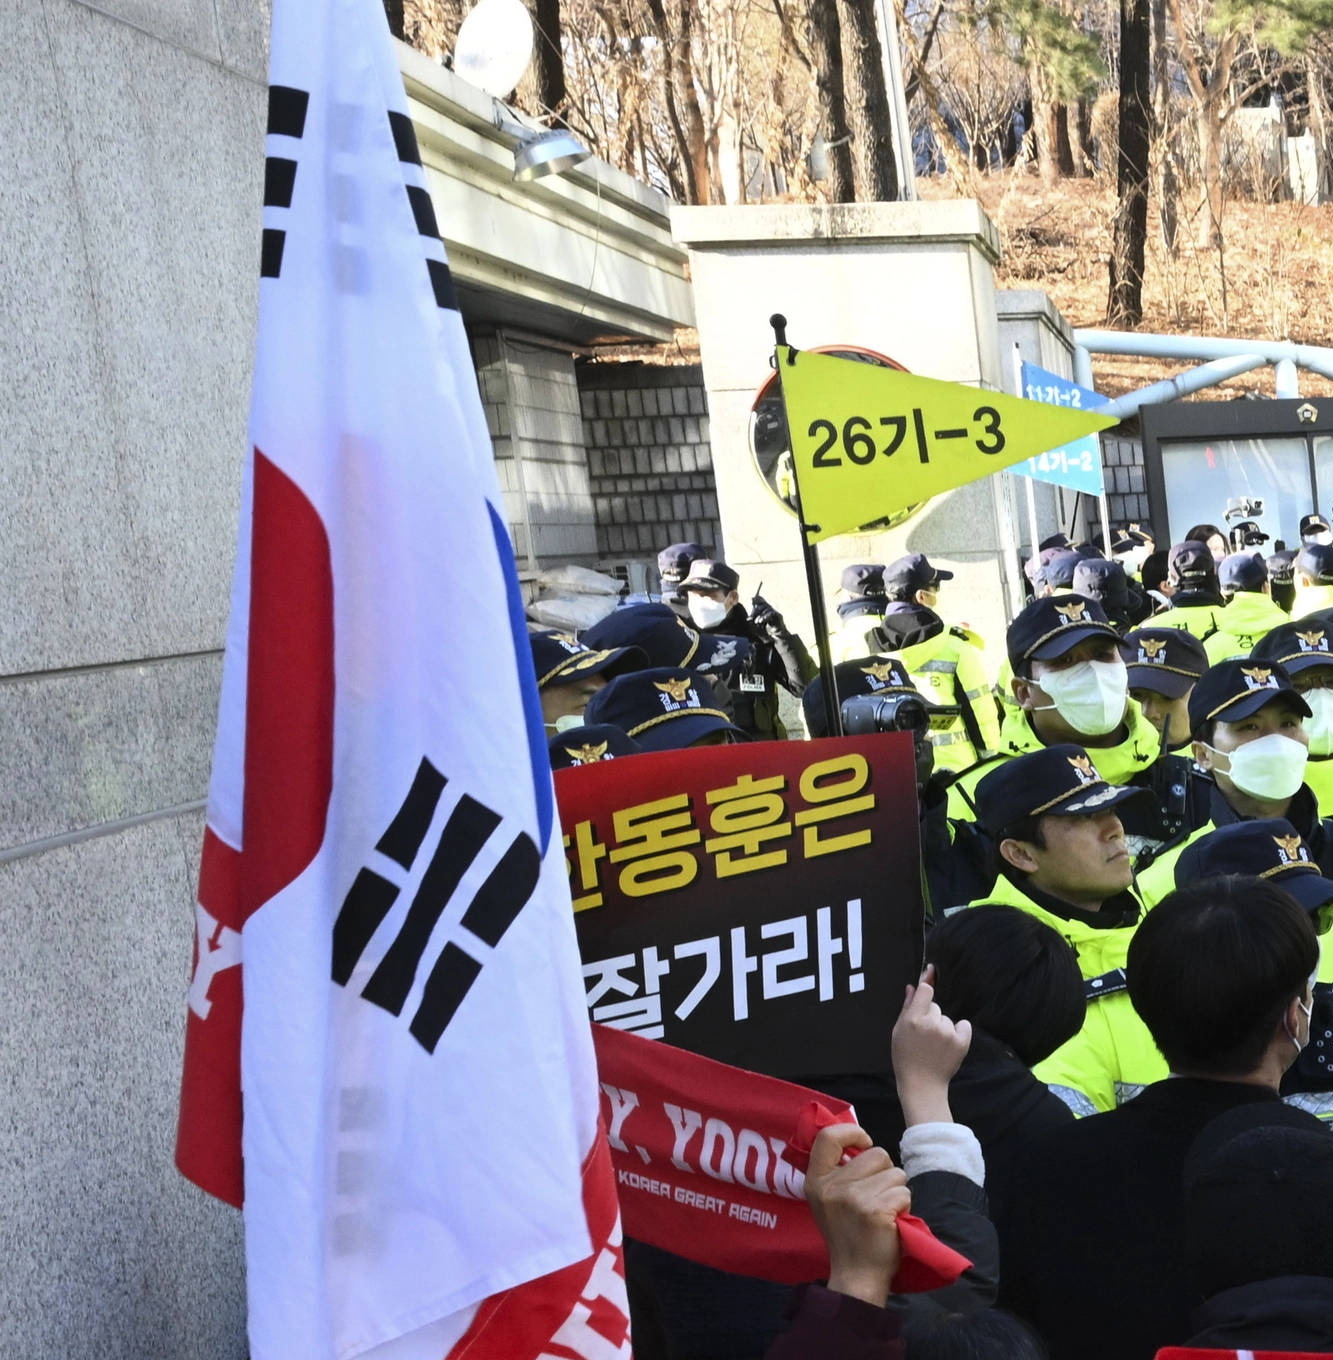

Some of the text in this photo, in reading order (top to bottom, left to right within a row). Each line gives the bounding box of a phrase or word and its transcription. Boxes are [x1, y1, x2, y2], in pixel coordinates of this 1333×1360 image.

[808, 406, 1007, 469] 26기-3
[618, 1169, 778, 1230] KOREA GREAT AGAIN
